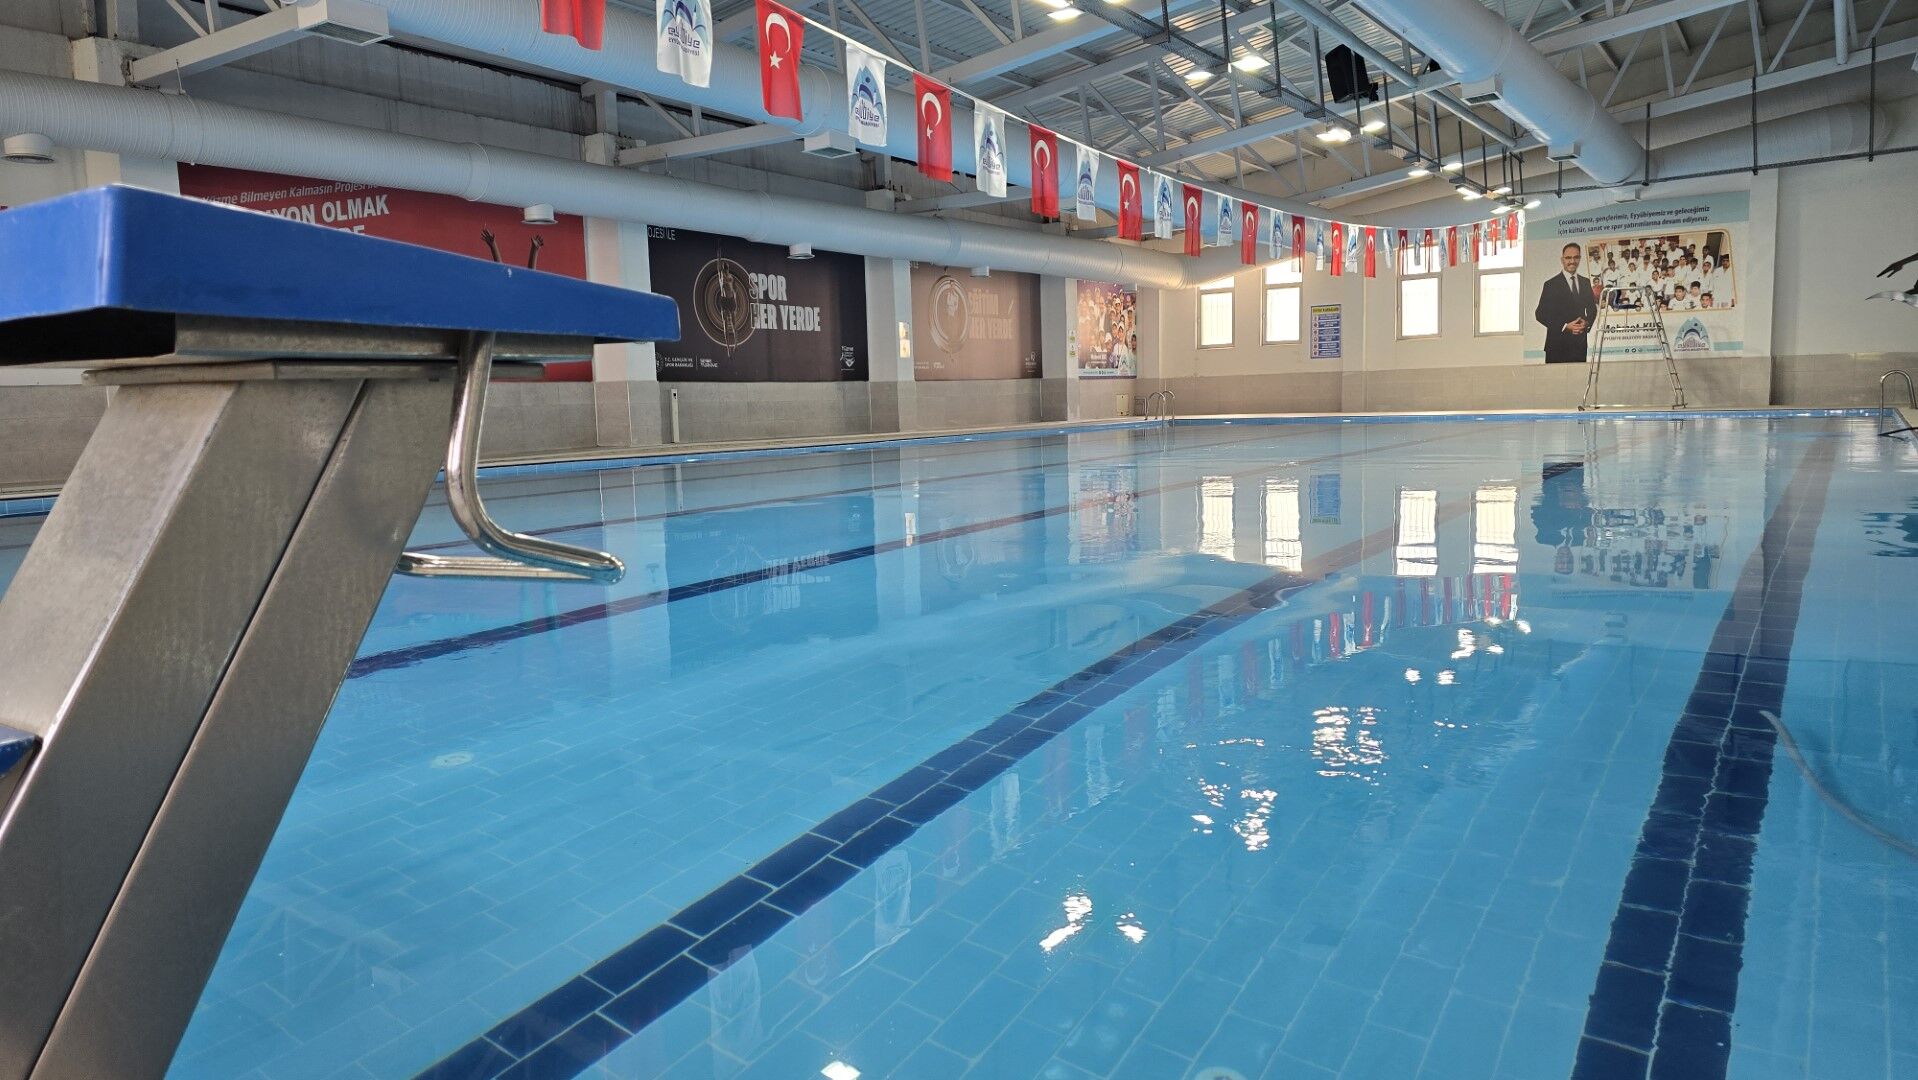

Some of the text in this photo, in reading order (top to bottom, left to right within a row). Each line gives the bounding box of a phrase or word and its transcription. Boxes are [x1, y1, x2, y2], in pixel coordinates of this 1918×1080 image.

[240, 190, 287, 203] Bilmeyen
[289, 184, 332, 197] Kalmasın
[322, 195, 389, 222] OLMAK
[1558, 227, 1568, 236] için
[749, 272, 787, 301] SPOR
[750, 303, 821, 331] HER YERDE
